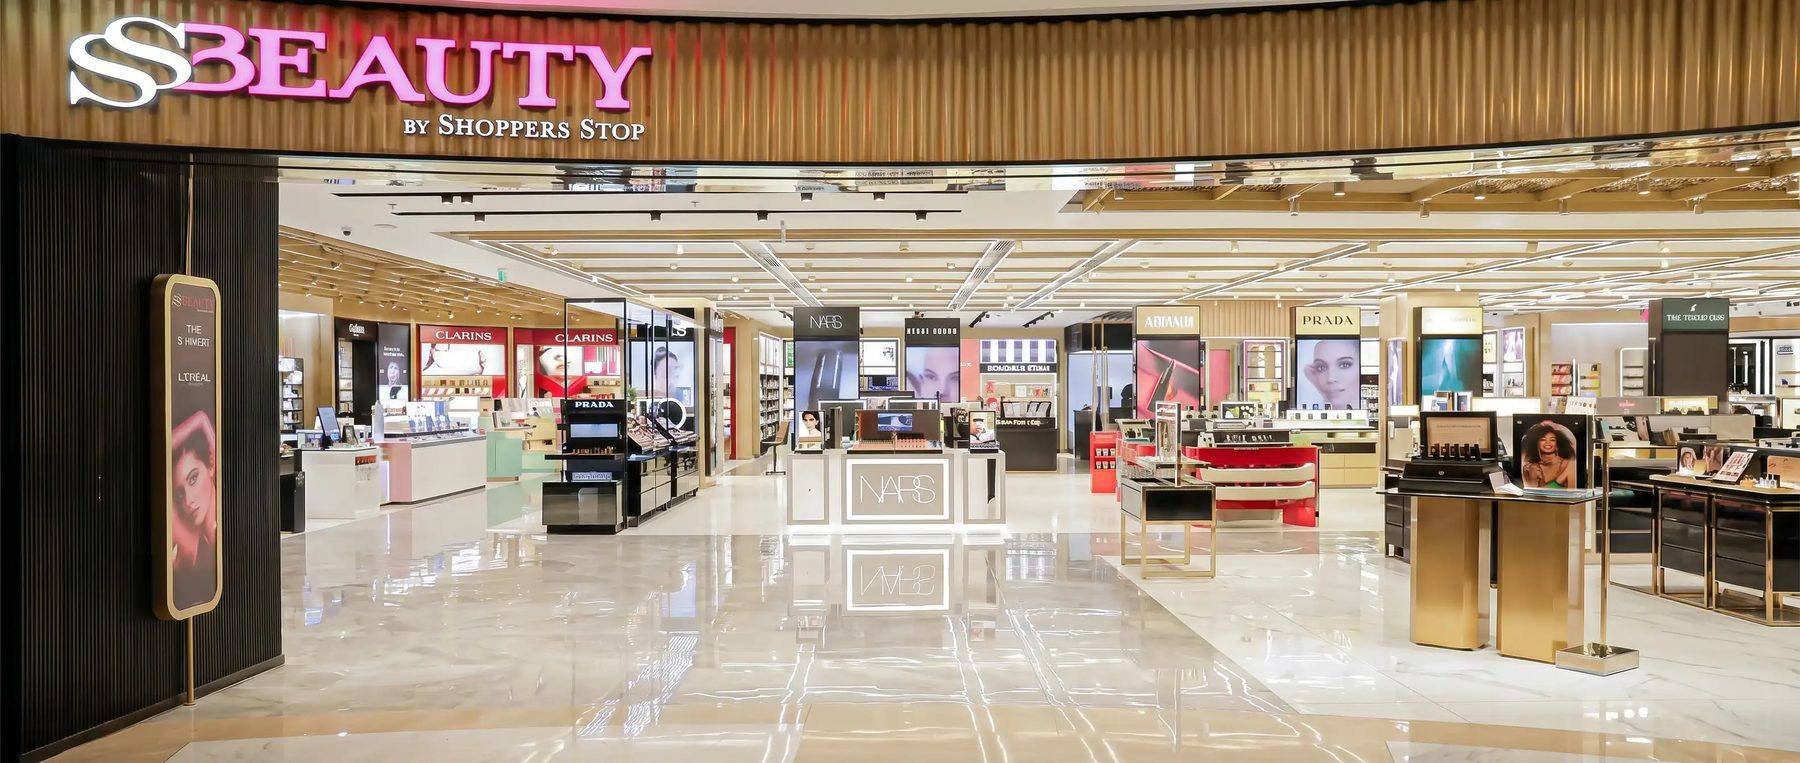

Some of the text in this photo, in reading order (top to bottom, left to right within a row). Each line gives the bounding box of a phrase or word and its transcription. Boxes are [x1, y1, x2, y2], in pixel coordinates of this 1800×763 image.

[438, 114, 570, 139] SHOPPERS
[580, 118, 645, 141] STOP
[809, 314, 843, 330] NARS
[1302, 315, 1354, 325] PRADA
[186, 324, 202, 335] THE
[435, 330, 492, 341] CLARINS
[555, 333, 613, 343] CLARINS
[860, 474, 936, 504] NARS
